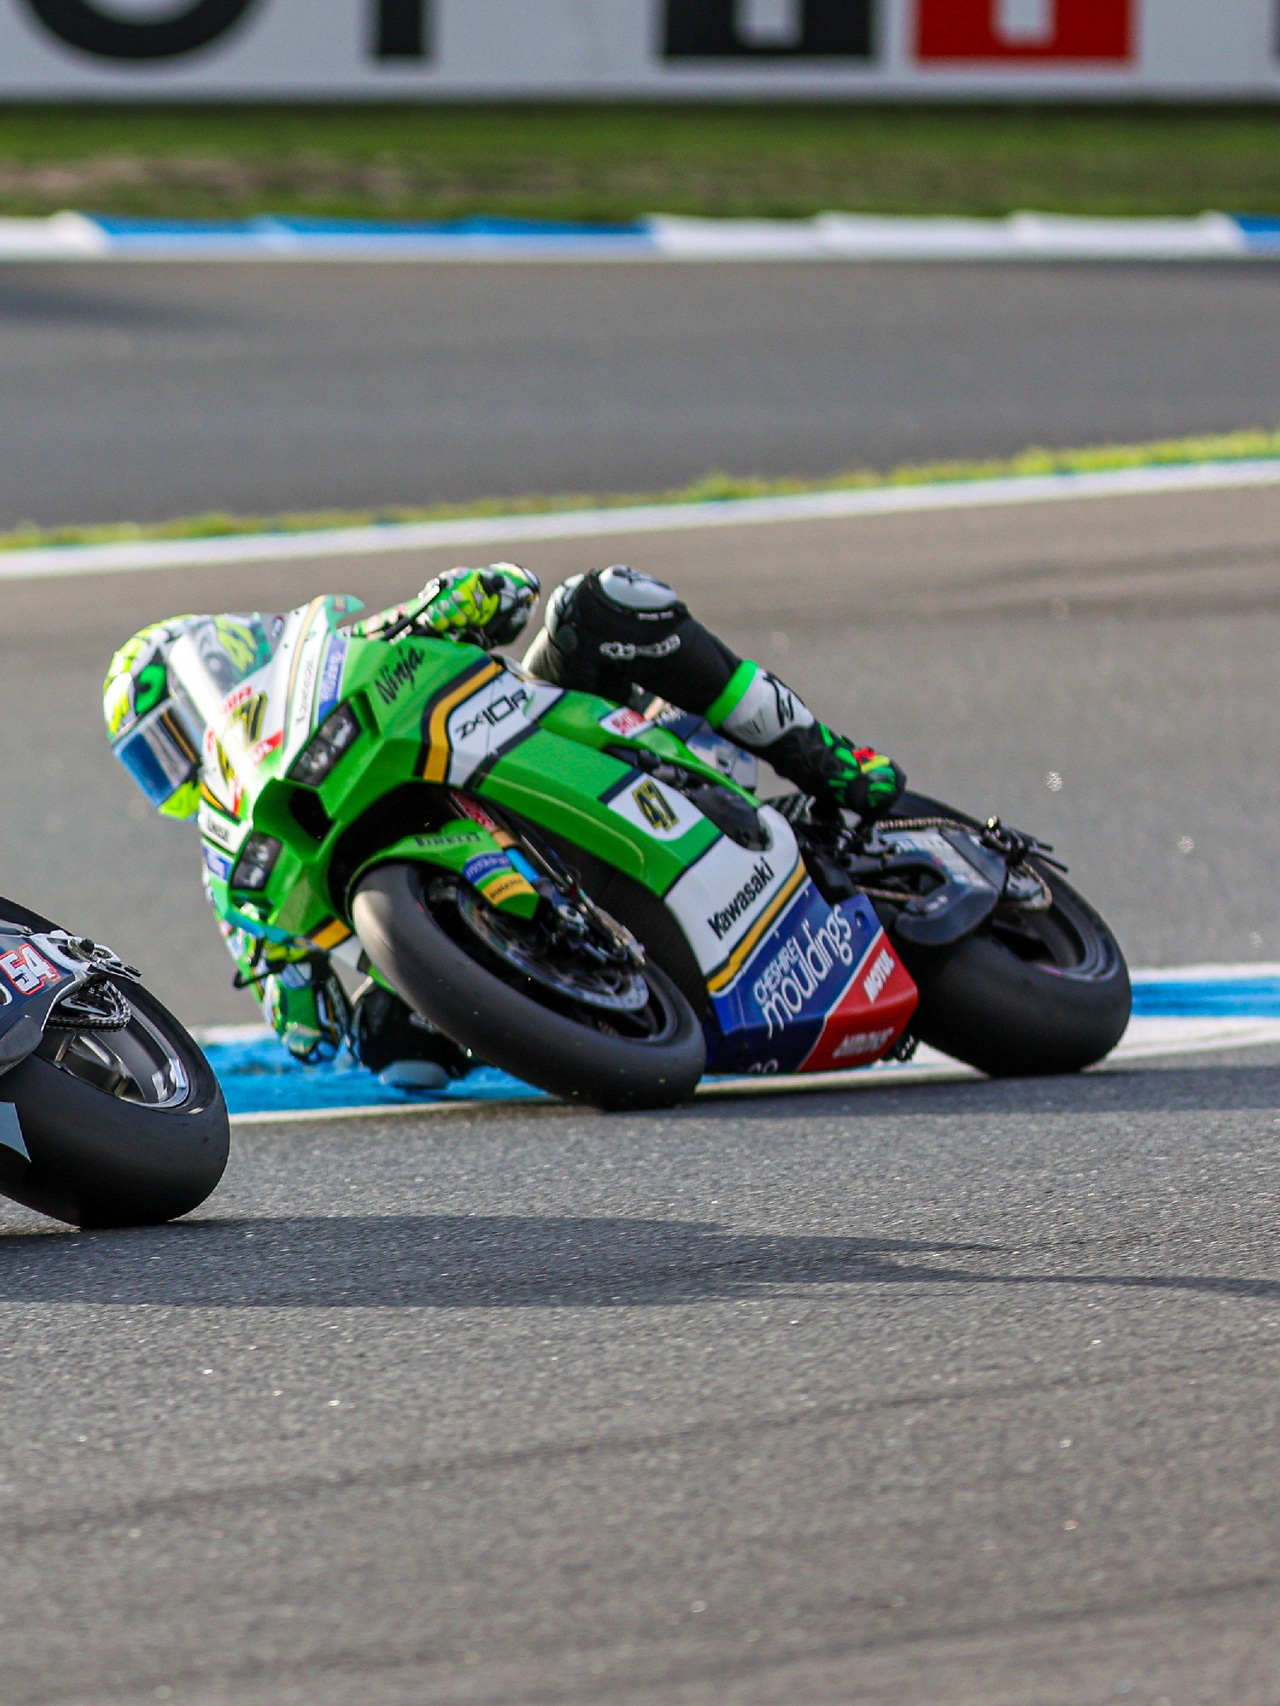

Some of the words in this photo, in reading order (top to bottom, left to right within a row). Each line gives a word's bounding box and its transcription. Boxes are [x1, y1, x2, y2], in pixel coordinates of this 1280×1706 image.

[374, 646, 425, 706] Ninja
[631, 780, 680, 832] 47
[707, 856, 775, 940] Kawasaki
[753, 937, 799, 1003] CHESHIRE
[762, 904, 853, 1040] mouldings
[863, 948, 896, 1004] MOTUL
